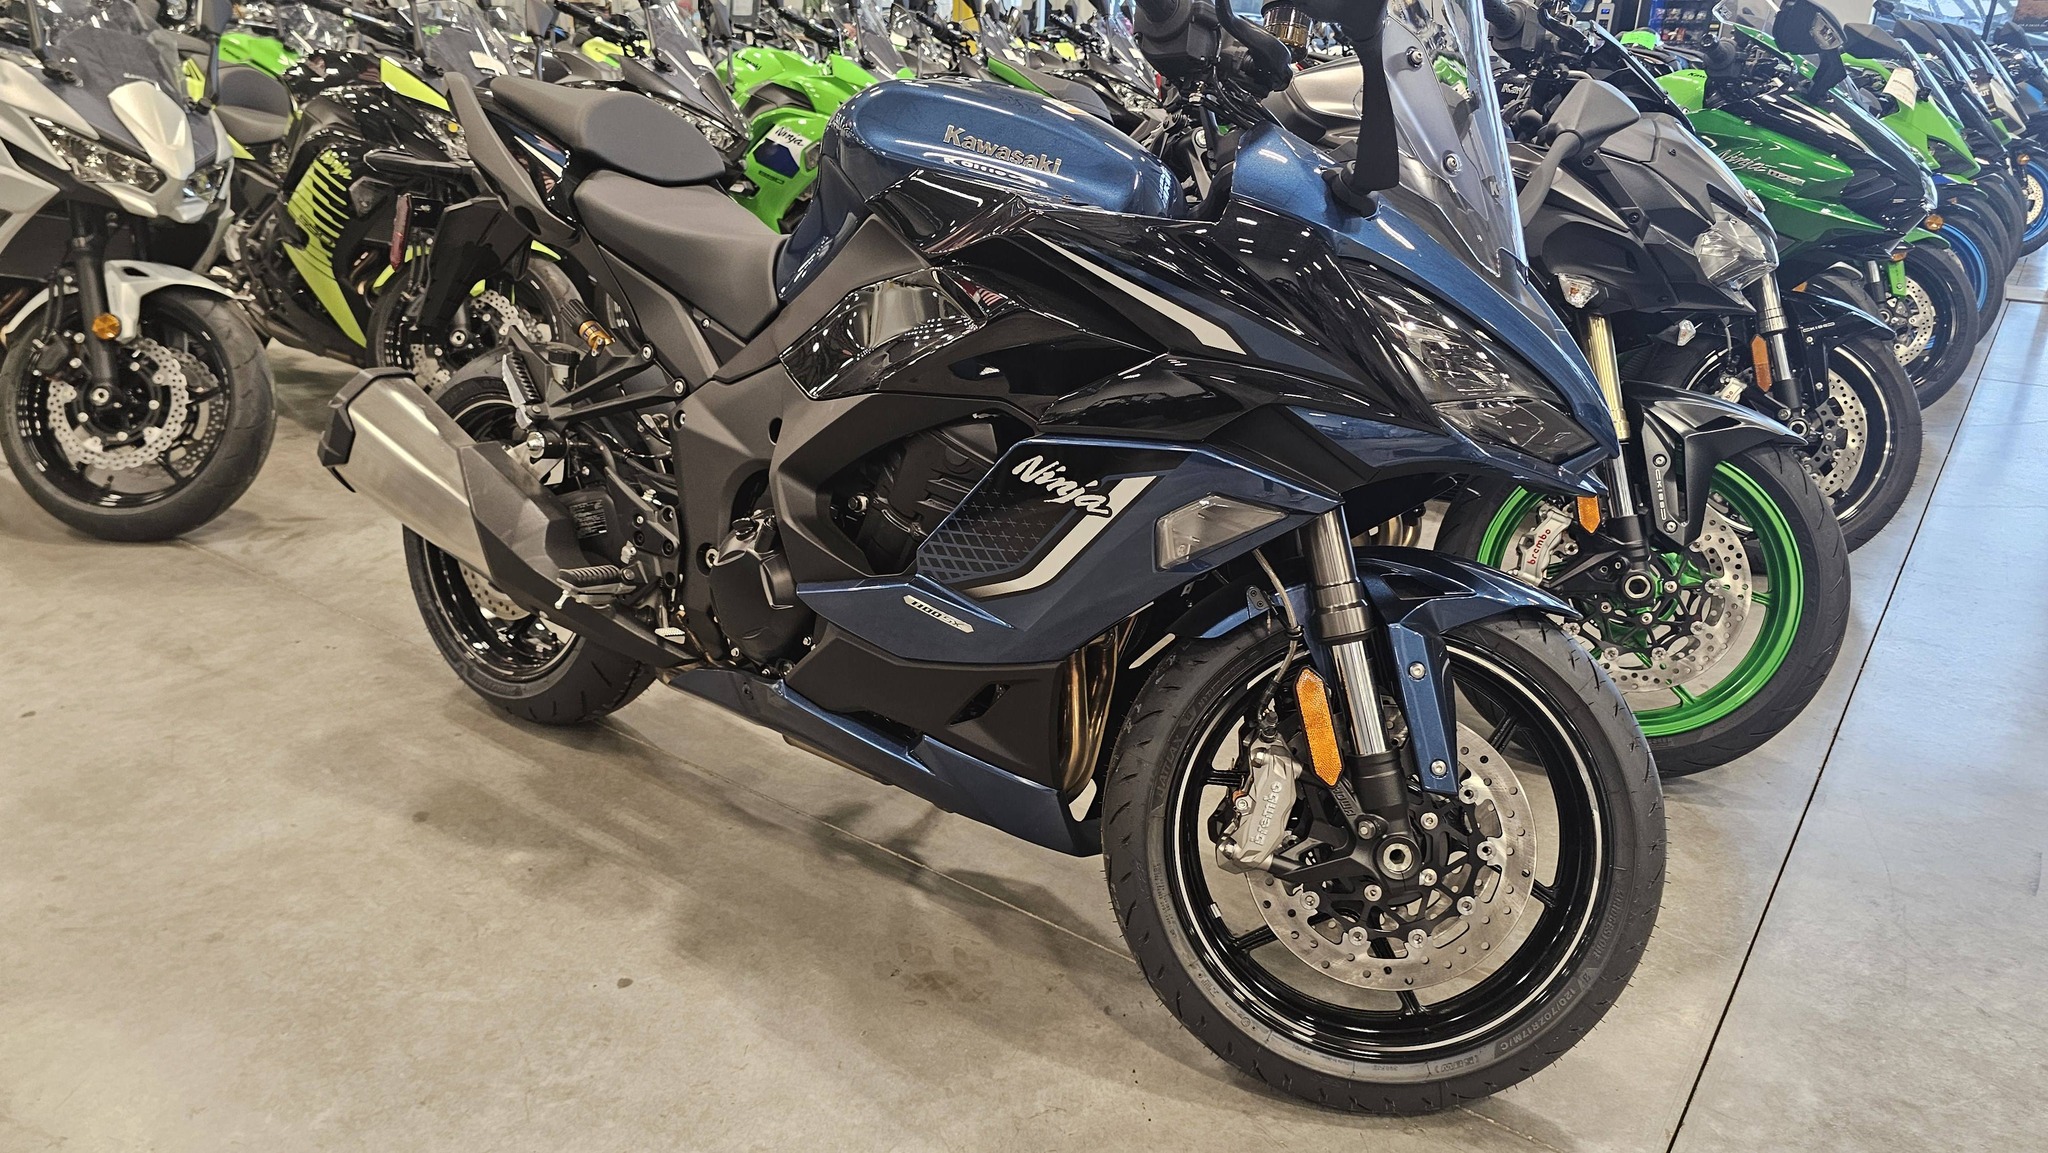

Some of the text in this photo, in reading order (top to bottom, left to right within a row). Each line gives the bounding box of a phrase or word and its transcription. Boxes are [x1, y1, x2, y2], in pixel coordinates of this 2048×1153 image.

[775, 126, 804, 147] Ninja
[943, 124, 1063, 175] Kawasaki
[1717, 149, 1768, 172] Ninja
[1011, 455, 1110, 515] Ninja
[1527, 528, 1552, 565] brembo
[1250, 780, 1283, 847] brembo
